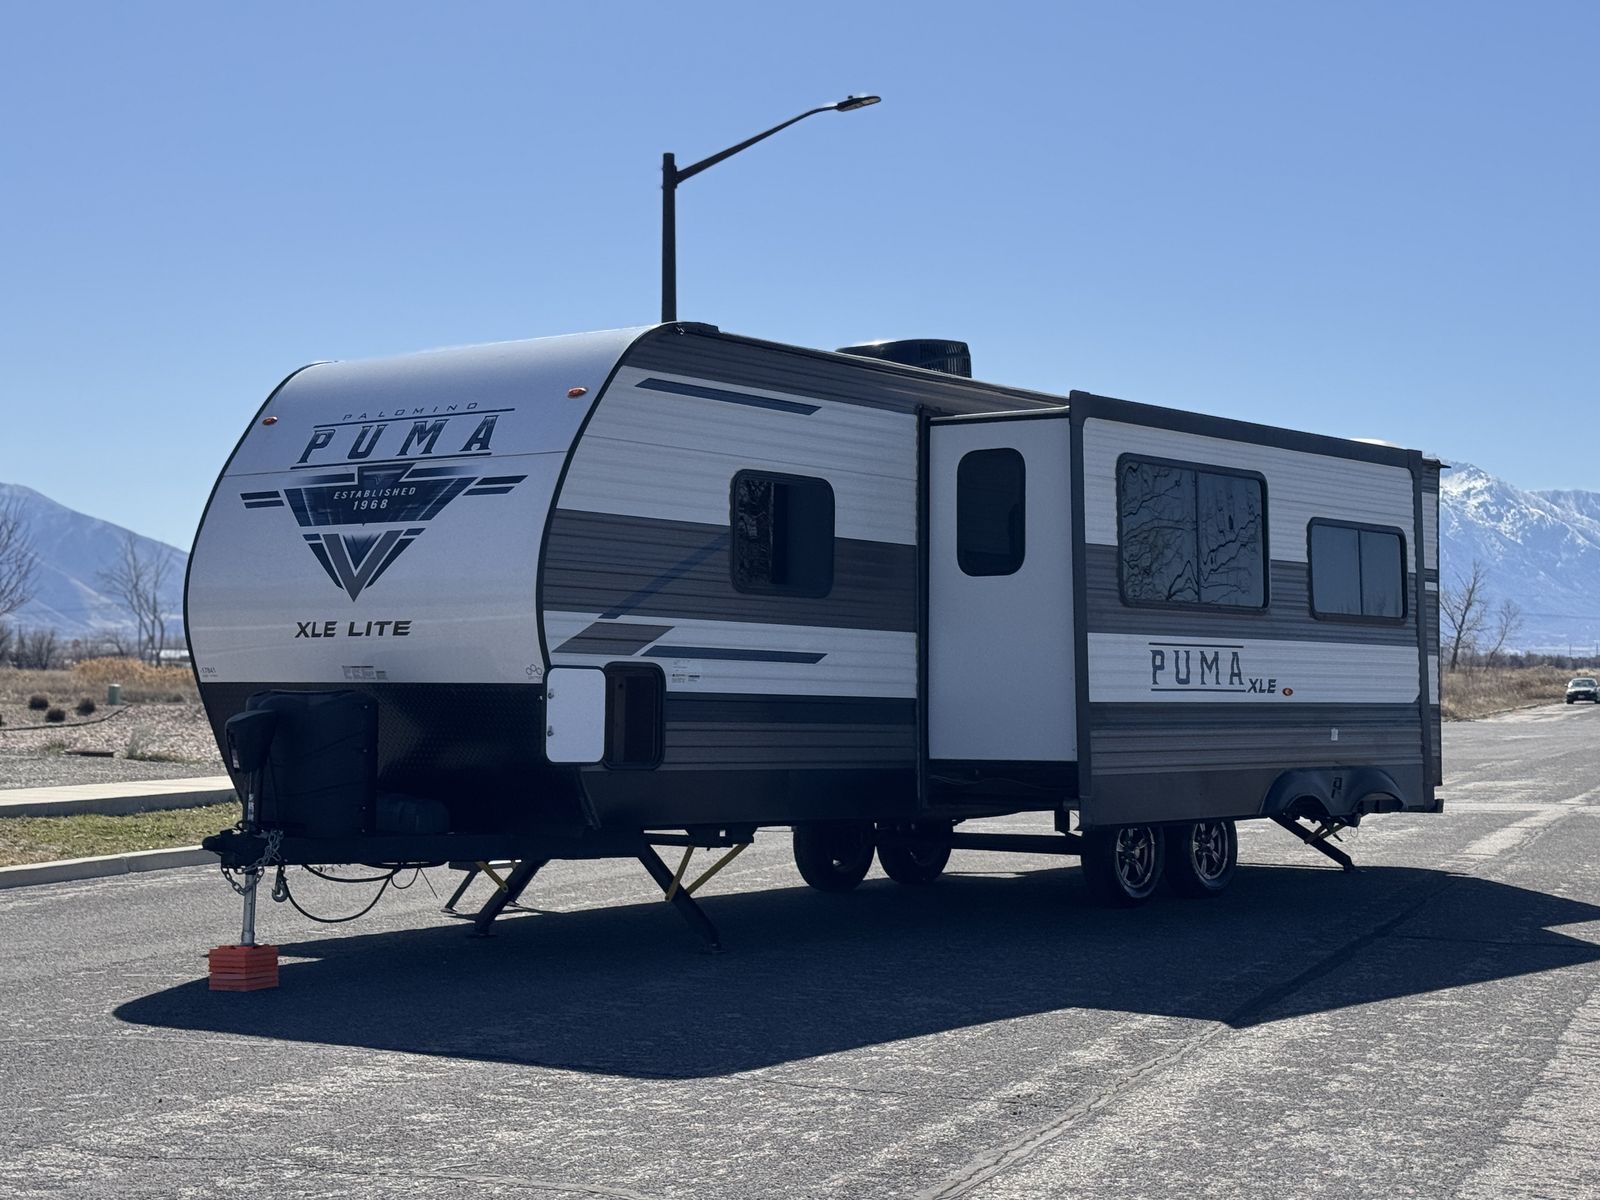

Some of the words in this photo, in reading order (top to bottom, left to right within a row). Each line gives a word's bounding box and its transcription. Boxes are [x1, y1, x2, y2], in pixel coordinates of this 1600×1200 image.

[343, 402, 479, 421] PALOMINO
[296, 414, 500, 464] PUMA
[333, 487, 416, 500] ESTABLISHED
[353, 499, 388, 510] 1968
[294, 621, 338, 638] XLE
[347, 620, 413, 636] LITE
[1150, 649, 1244, 685] PUMA
[1247, 678, 1277, 693] XLE
